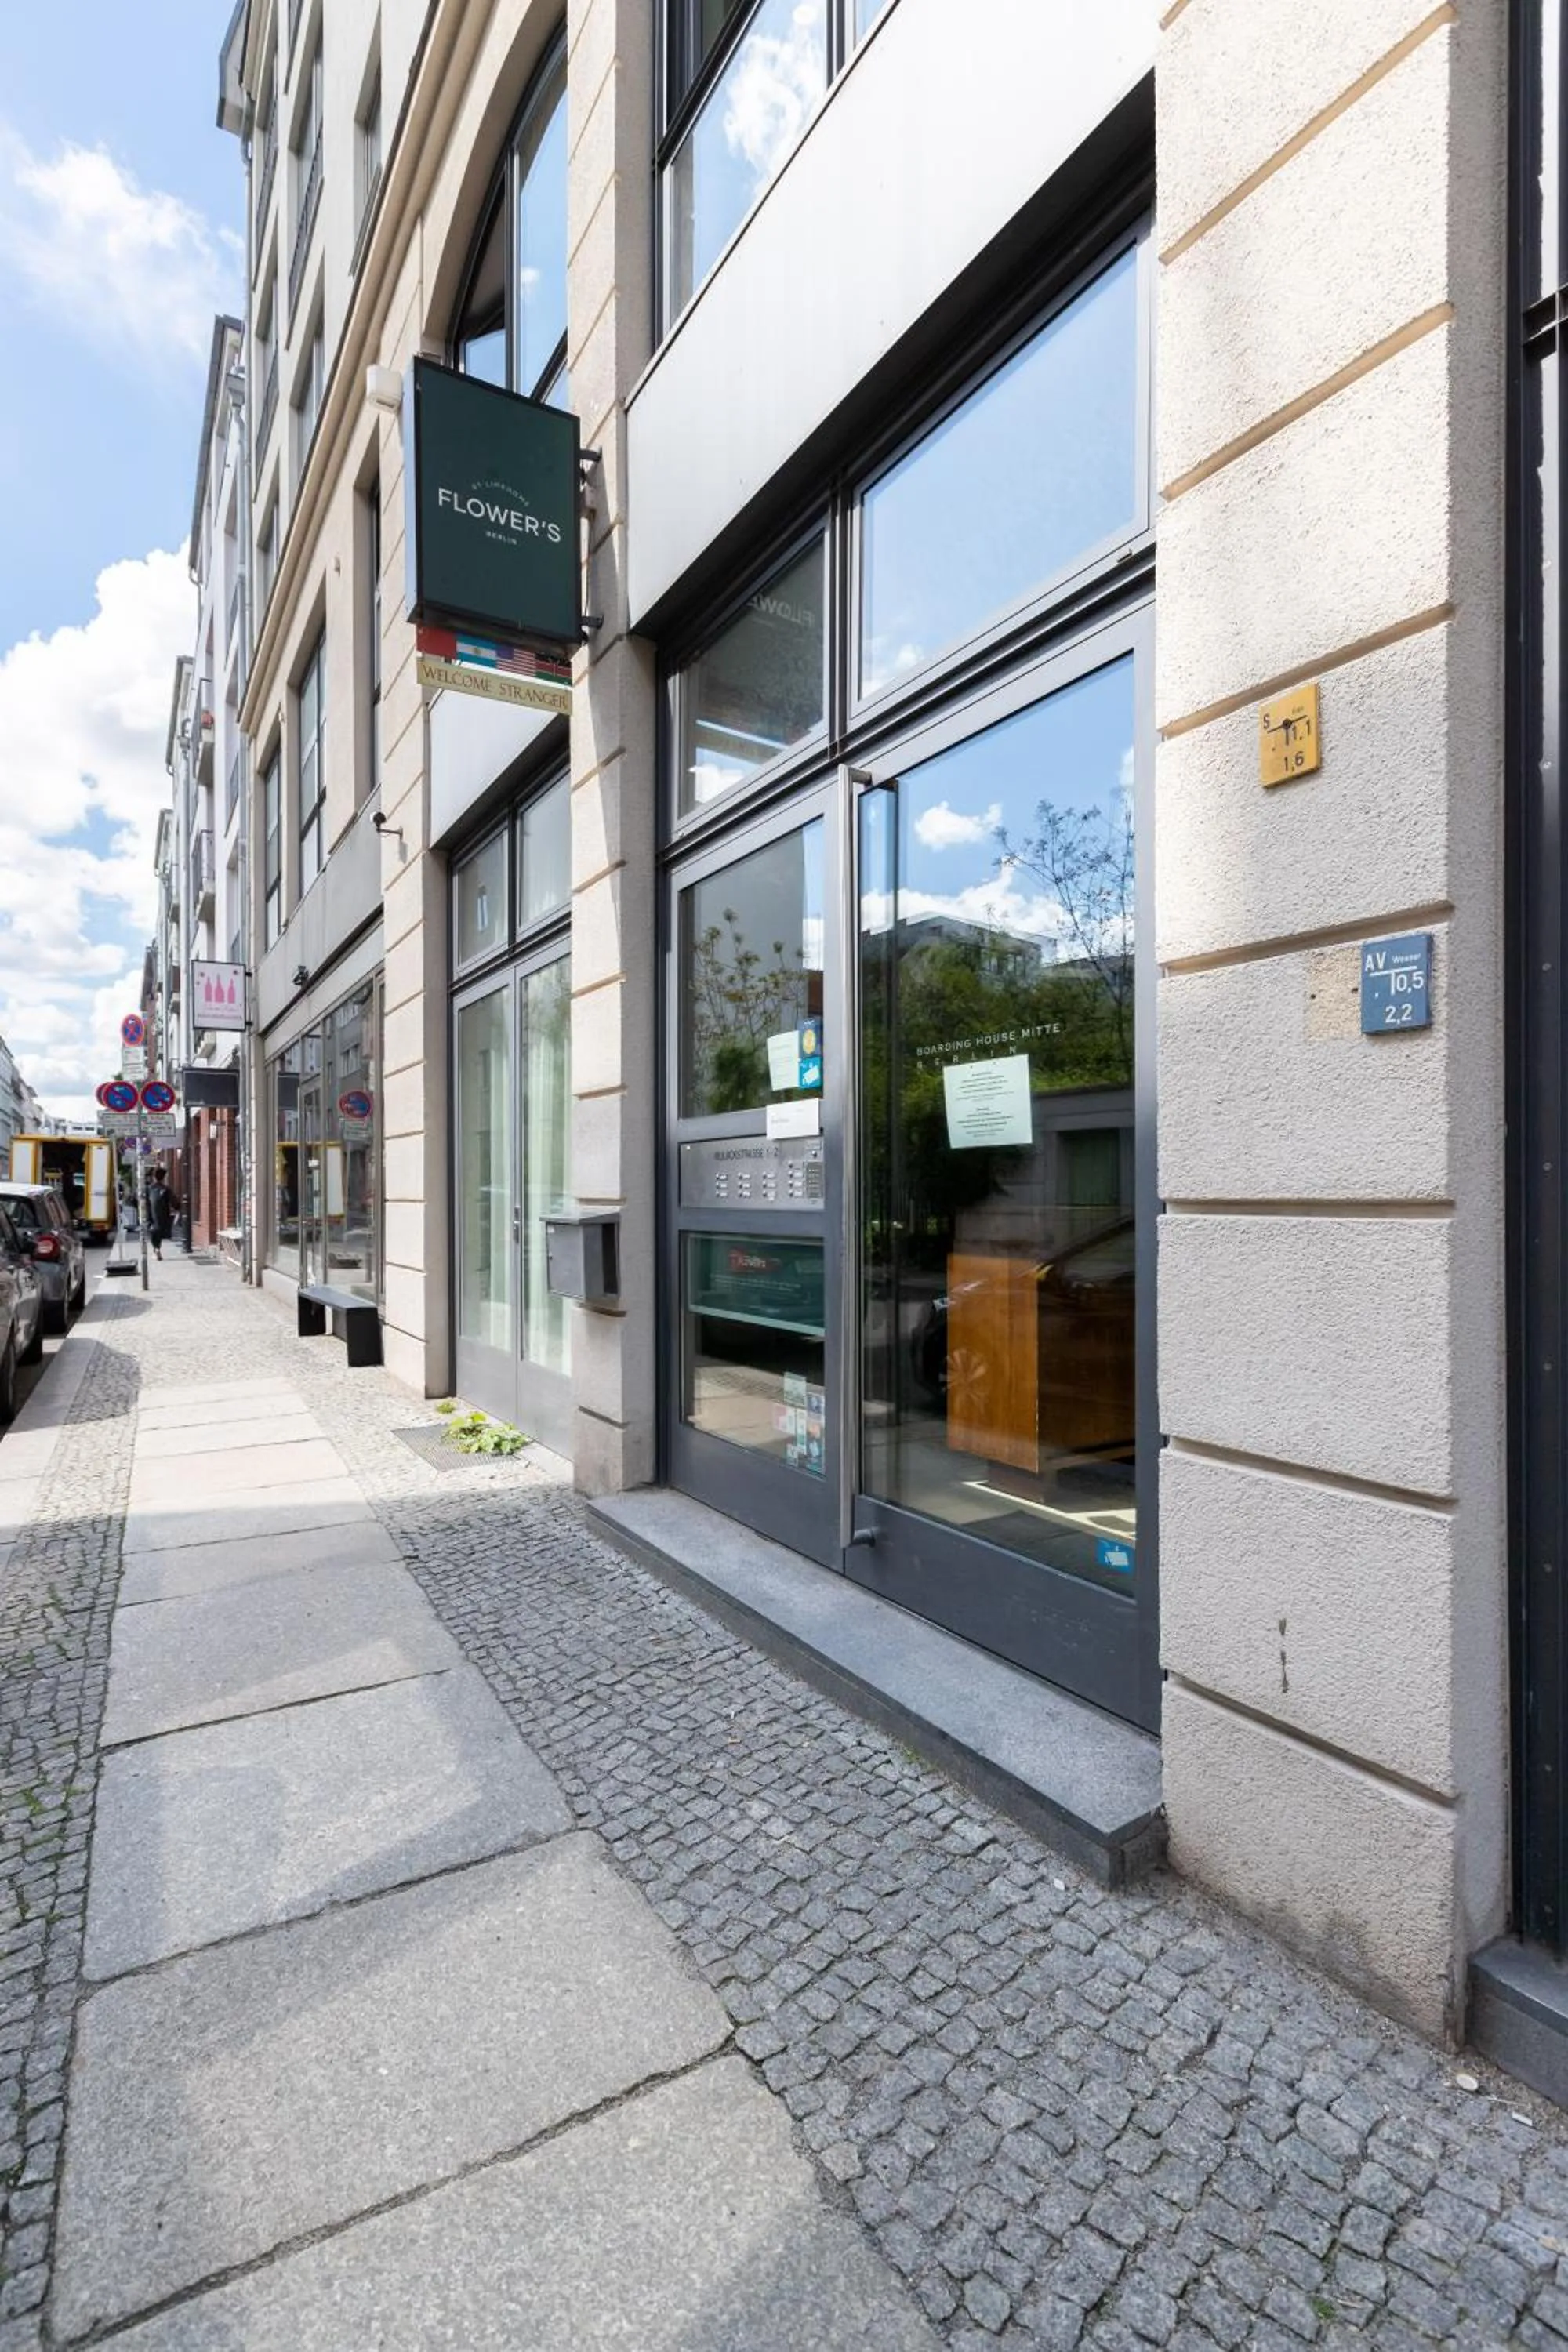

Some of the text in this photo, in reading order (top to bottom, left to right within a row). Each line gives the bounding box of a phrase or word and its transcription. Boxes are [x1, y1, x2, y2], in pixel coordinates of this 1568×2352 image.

[437, 487, 561, 543] FLOWER'S
[423, 665, 569, 709] WELCOME STRANGER
[1263, 713, 1270, 730] S
[1365, 951, 1387, 971] AV
[1385, 1003, 1412, 1025] 2,2
[916, 1022, 1061, 1057] BOARDING HOUSE MITTE
